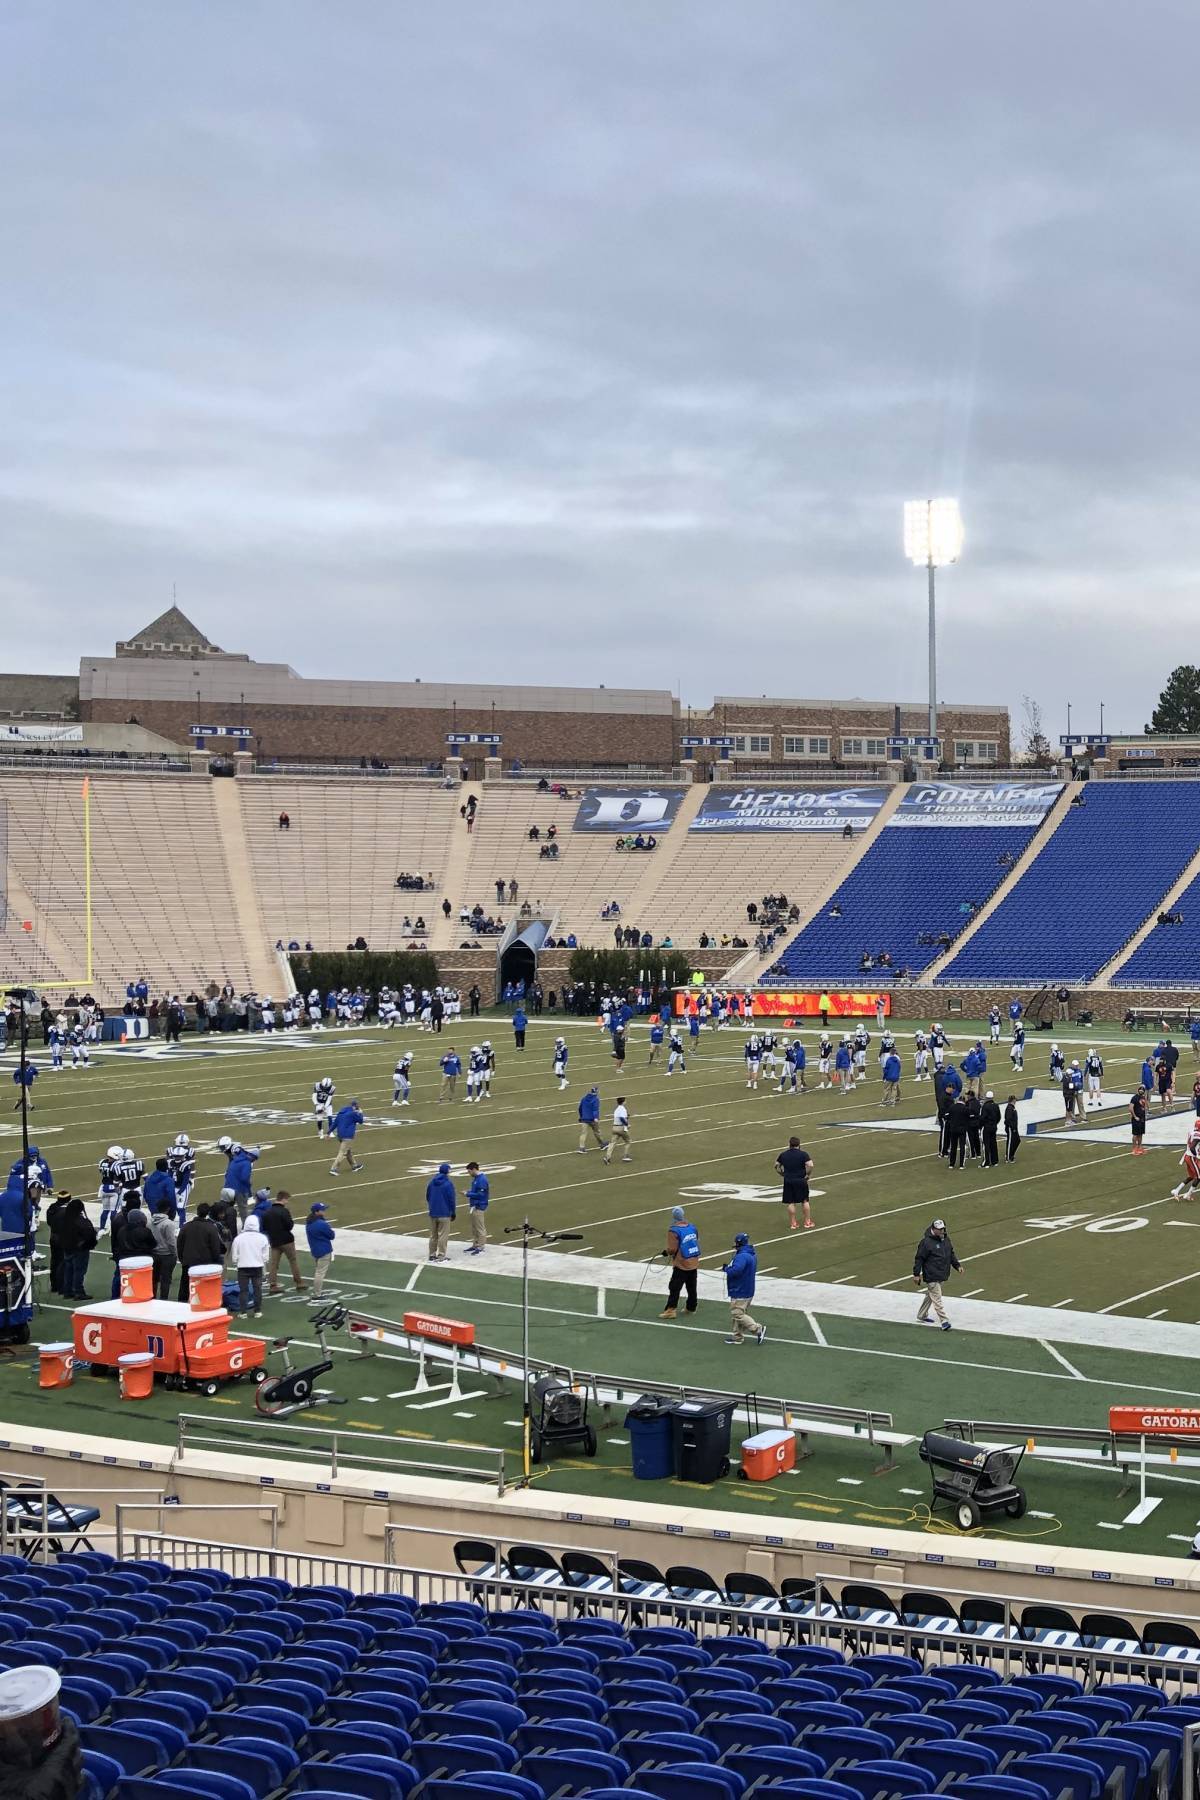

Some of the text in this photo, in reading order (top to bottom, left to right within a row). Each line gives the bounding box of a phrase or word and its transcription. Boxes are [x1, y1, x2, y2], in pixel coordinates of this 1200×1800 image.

[729, 793, 858, 809] HEROES
[914, 789, 1045, 804] CORNER
[735, 808, 839, 818] Military &
[924, 804, 1018, 813] Thank You
[699, 816, 868, 827] First Responders
[974, 813, 1042, 822] Service
[123, 1168, 137, 1182] 10
[1023, 1213, 1150, 1233] 40
[120, 1274, 129, 1286] G
[416, 1320, 452, 1337] GATORADE
[82, 1322, 102, 1354] G
[229, 1352, 243, 1369] G
[776, 1444, 785, 1461] G
